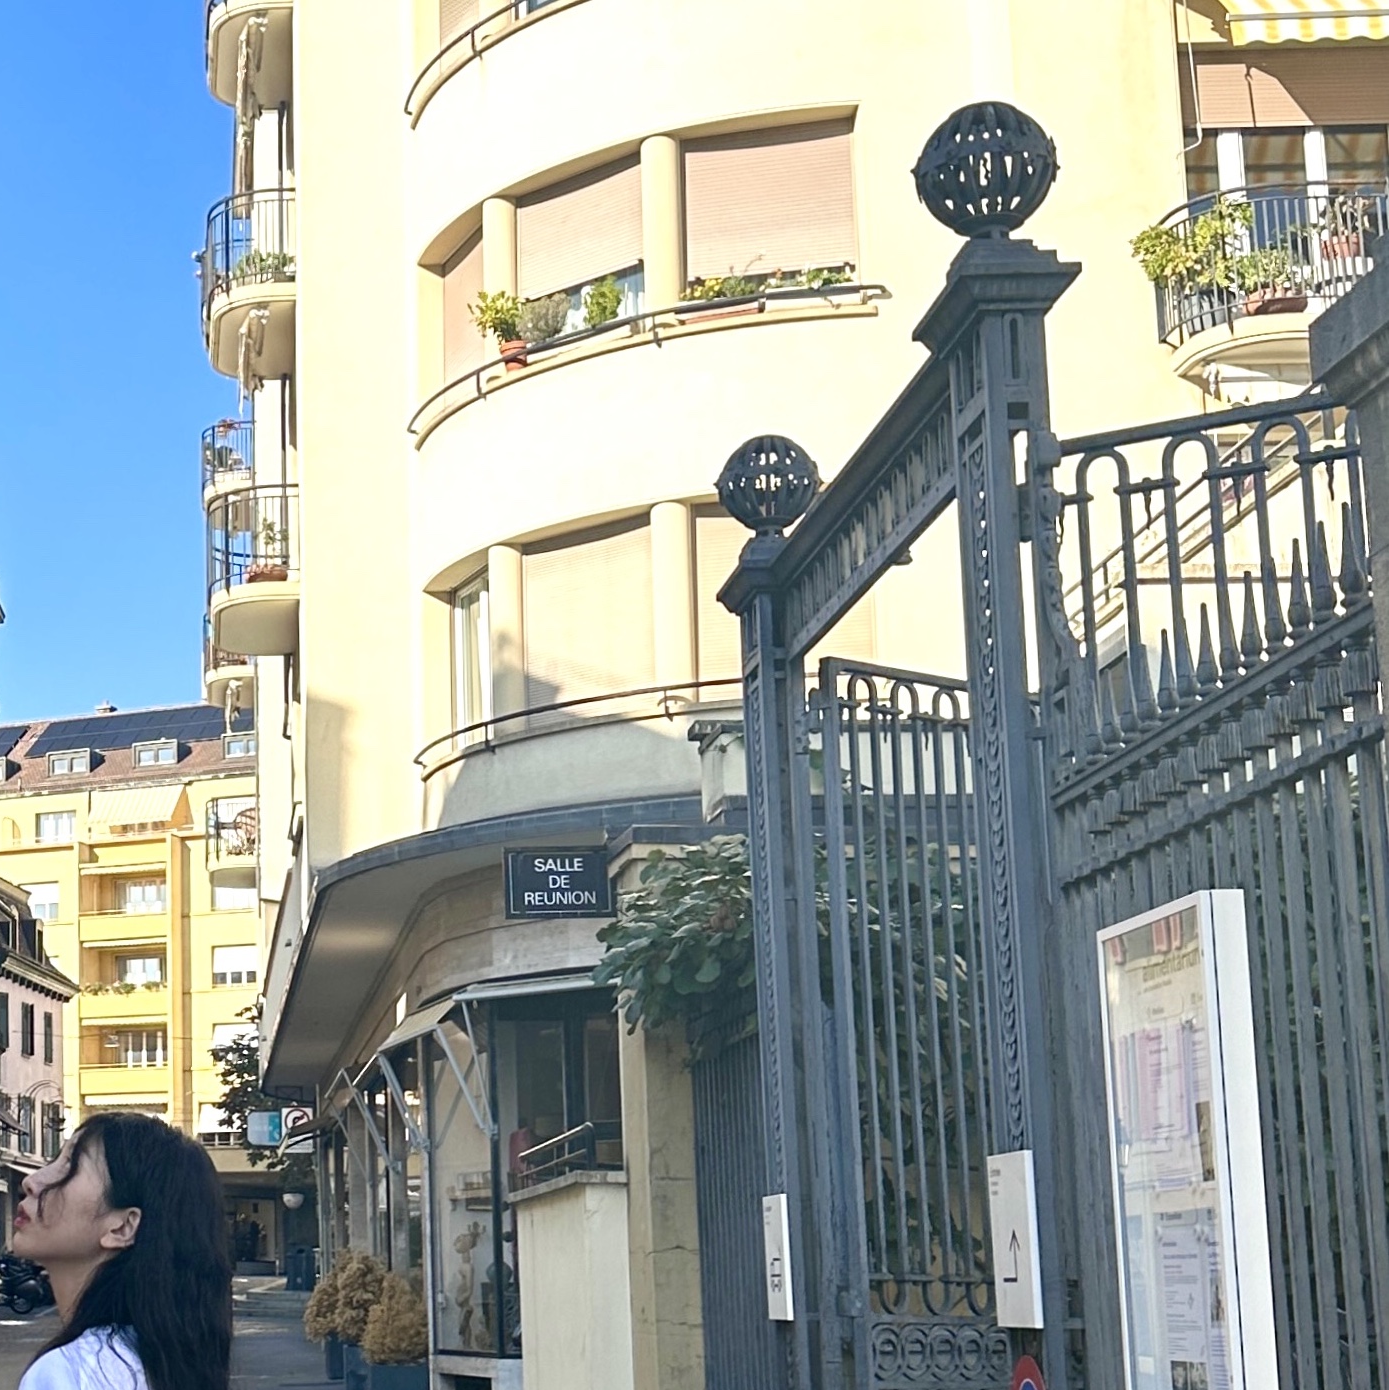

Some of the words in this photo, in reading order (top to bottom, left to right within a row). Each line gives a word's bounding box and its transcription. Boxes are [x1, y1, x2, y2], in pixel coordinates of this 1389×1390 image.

[533, 857, 584, 872] SALLE
[548, 875, 570, 888] DE
[524, 891, 596, 905] REUNION
